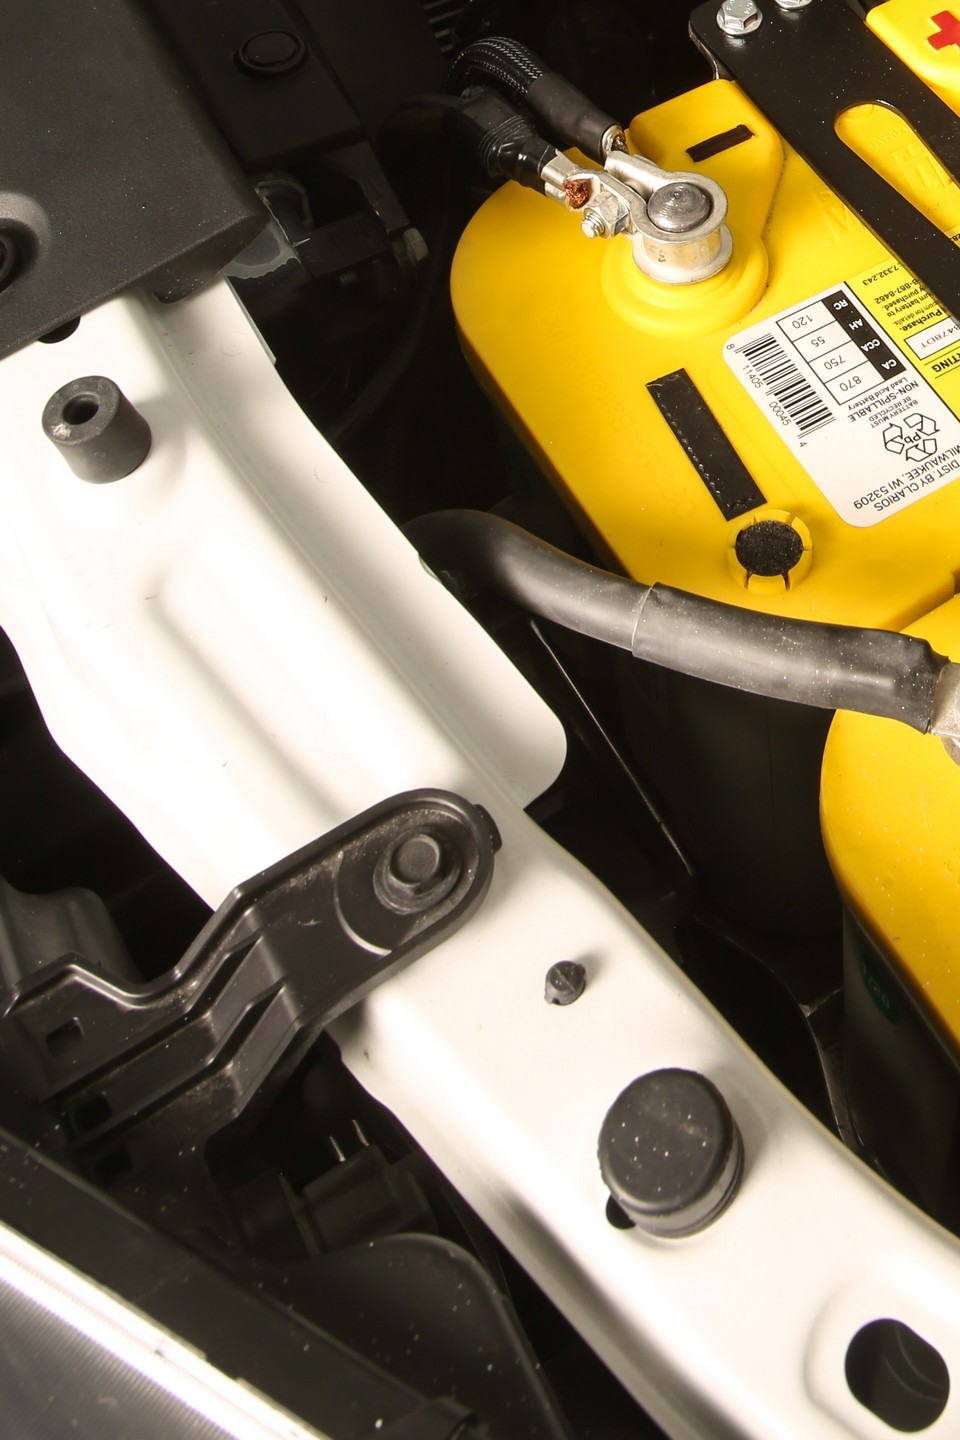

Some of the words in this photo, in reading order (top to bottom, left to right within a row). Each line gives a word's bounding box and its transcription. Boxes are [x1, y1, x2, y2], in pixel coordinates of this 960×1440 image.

[832, 298, 849, 311] RC
[880, 287, 920, 312] purchased.
[790, 313, 813, 329] 120
[847, 317, 863, 331] AH
[898, 307, 943, 332] Purchase.
[809, 335, 826, 348] 55
[859, 337, 881, 352] CCA
[822, 353, 846, 371] 750
[880, 358, 897, 370] CA
[838, 374, 862, 392] 870
[888, 375, 909, 390] Lead
[872, 384, 890, 399] Acid
[901, 395, 912, 404] BE
[846, 379, 920, 423] NON-SPILLABLE
[846, 393, 876, 411] Battery
[888, 398, 919, 419] BATTERY
[867, 400, 903, 422] RECYCLED
[869, 414, 890, 429] MUST
[902, 430, 922, 444] Pb
[932, 458, 960, 478] DIST.
[886, 477, 905, 491] WI
[918, 472, 936, 488] BY
[852, 484, 889, 510] 53209
[872, 481, 920, 512] CLARIOS
